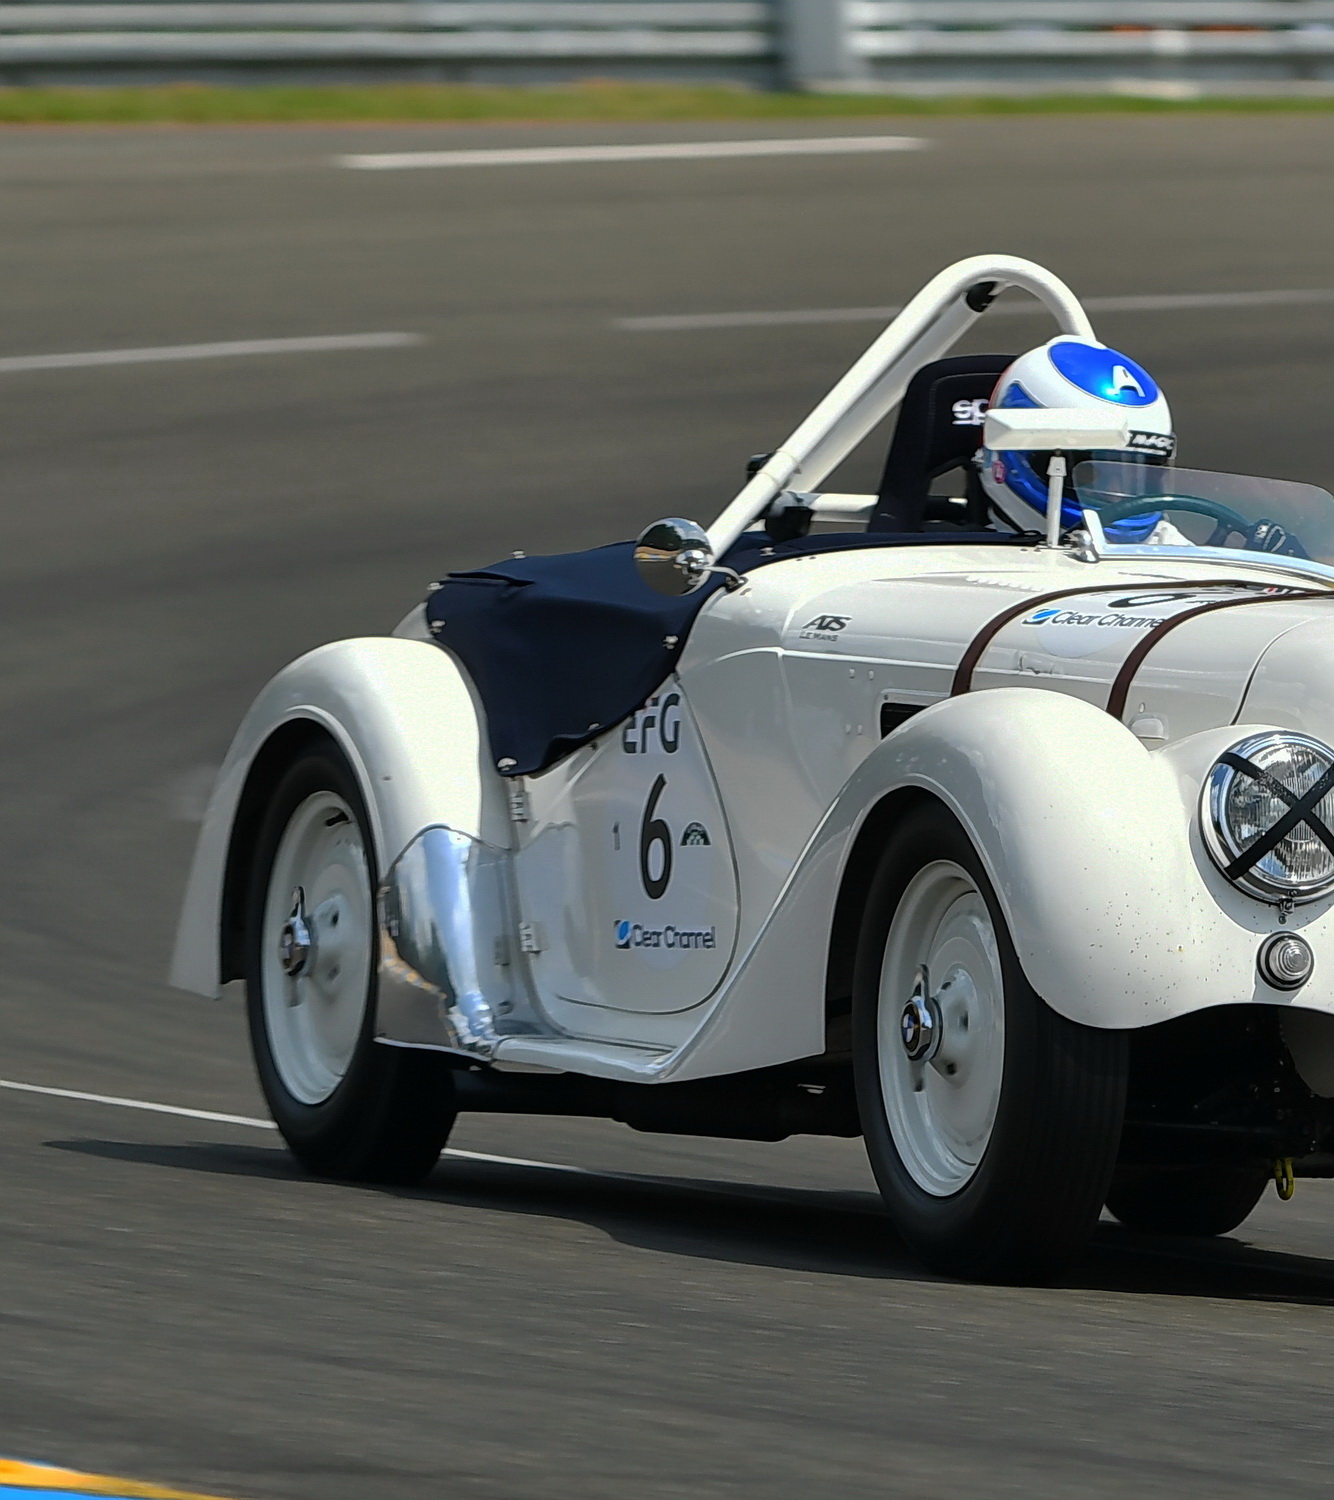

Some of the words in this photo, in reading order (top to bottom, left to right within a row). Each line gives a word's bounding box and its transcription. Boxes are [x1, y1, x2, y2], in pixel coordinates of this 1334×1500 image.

[1106, 365, 1146, 398] A
[1051, 611, 1099, 626] Clear
[1097, 613, 1165, 629] Channe
[639, 773, 672, 900] 6
